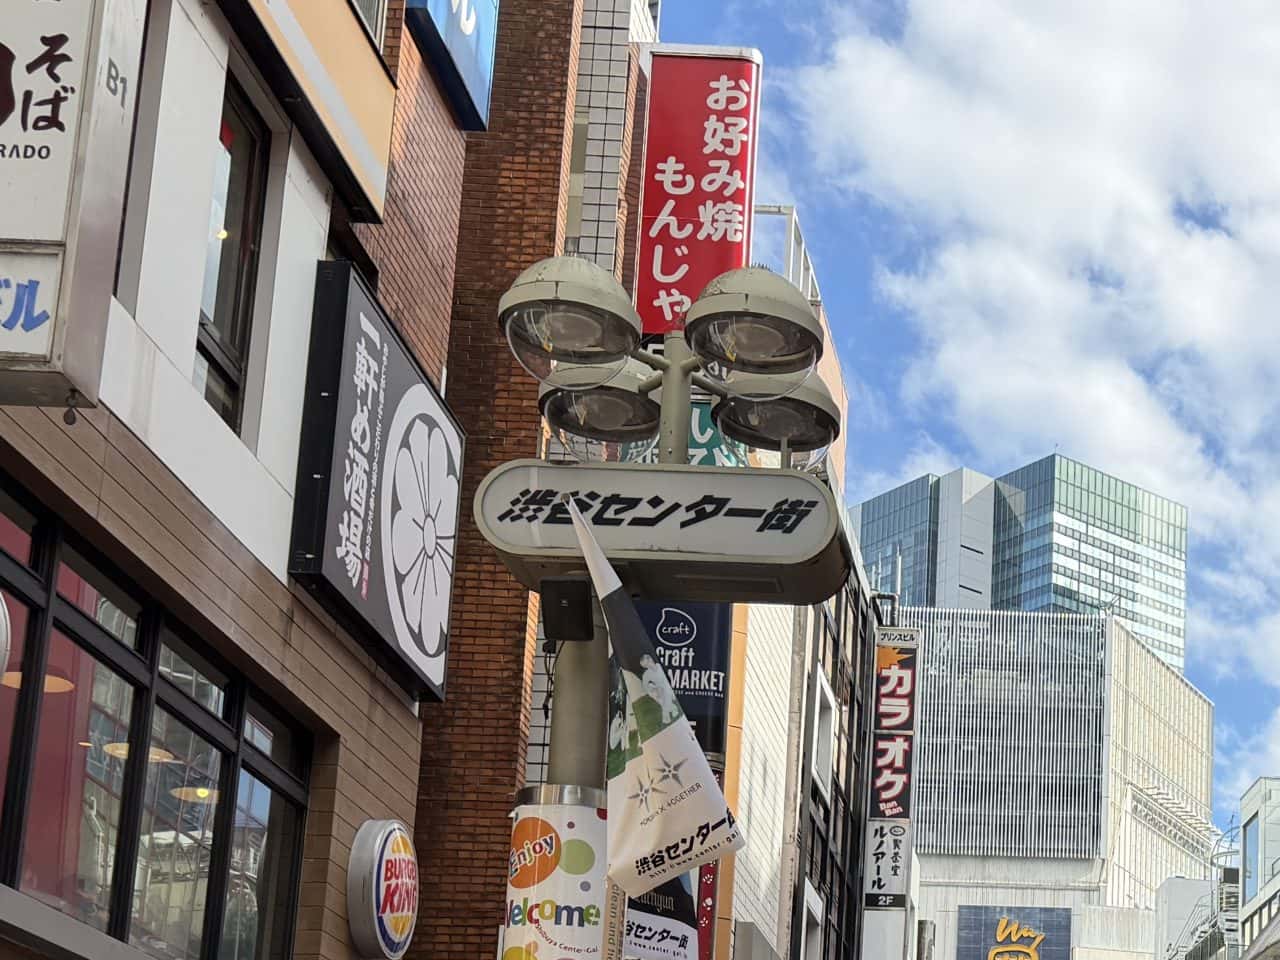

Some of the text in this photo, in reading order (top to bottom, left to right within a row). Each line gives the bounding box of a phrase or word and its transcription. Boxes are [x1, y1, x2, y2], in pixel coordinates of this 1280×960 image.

[21, 33, 75, 132] そば
[697, 74, 749, 243] お好み焼
[649, 156, 696, 322] もんじゃ
[497, 487, 820, 535] 渋谷センター街
[874, 664, 912, 801] カラオケ
[625, 919, 689, 950] 谷センター街
